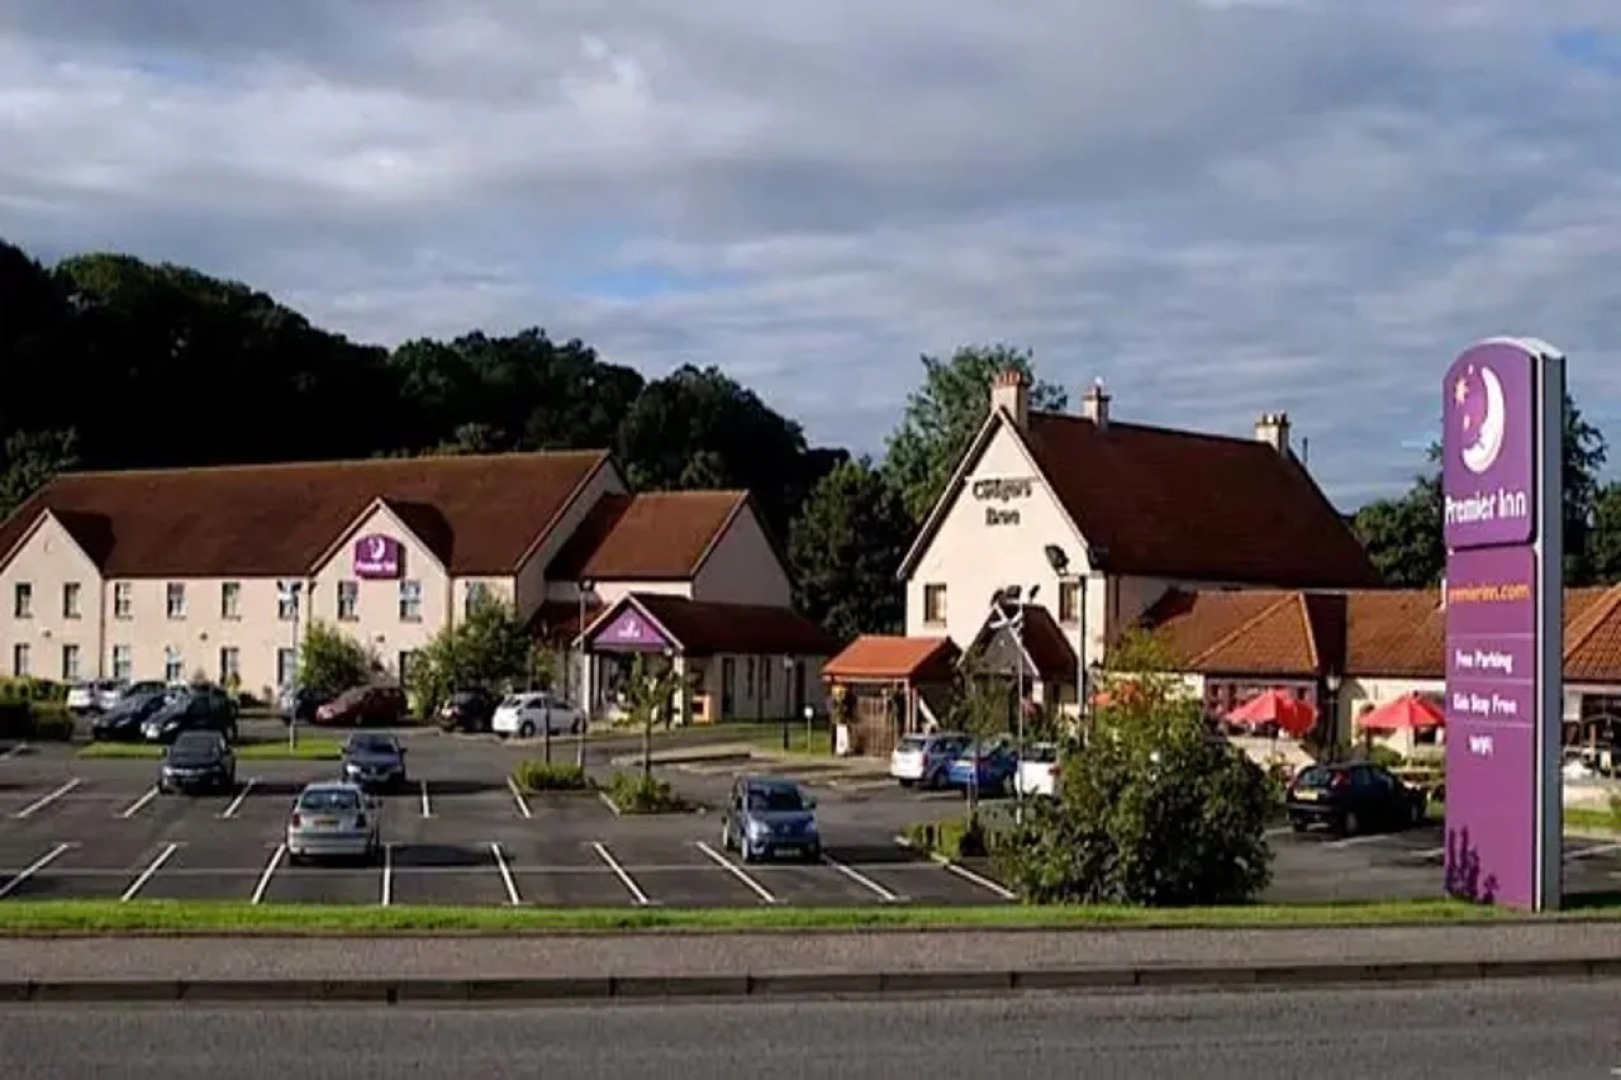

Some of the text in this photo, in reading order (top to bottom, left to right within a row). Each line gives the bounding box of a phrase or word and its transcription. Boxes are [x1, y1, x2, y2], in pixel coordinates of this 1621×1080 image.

[1445, 486, 1526, 525] Premier Inn
[1475, 649, 1513, 674] Parking
[1492, 693, 1517, 714] Free
